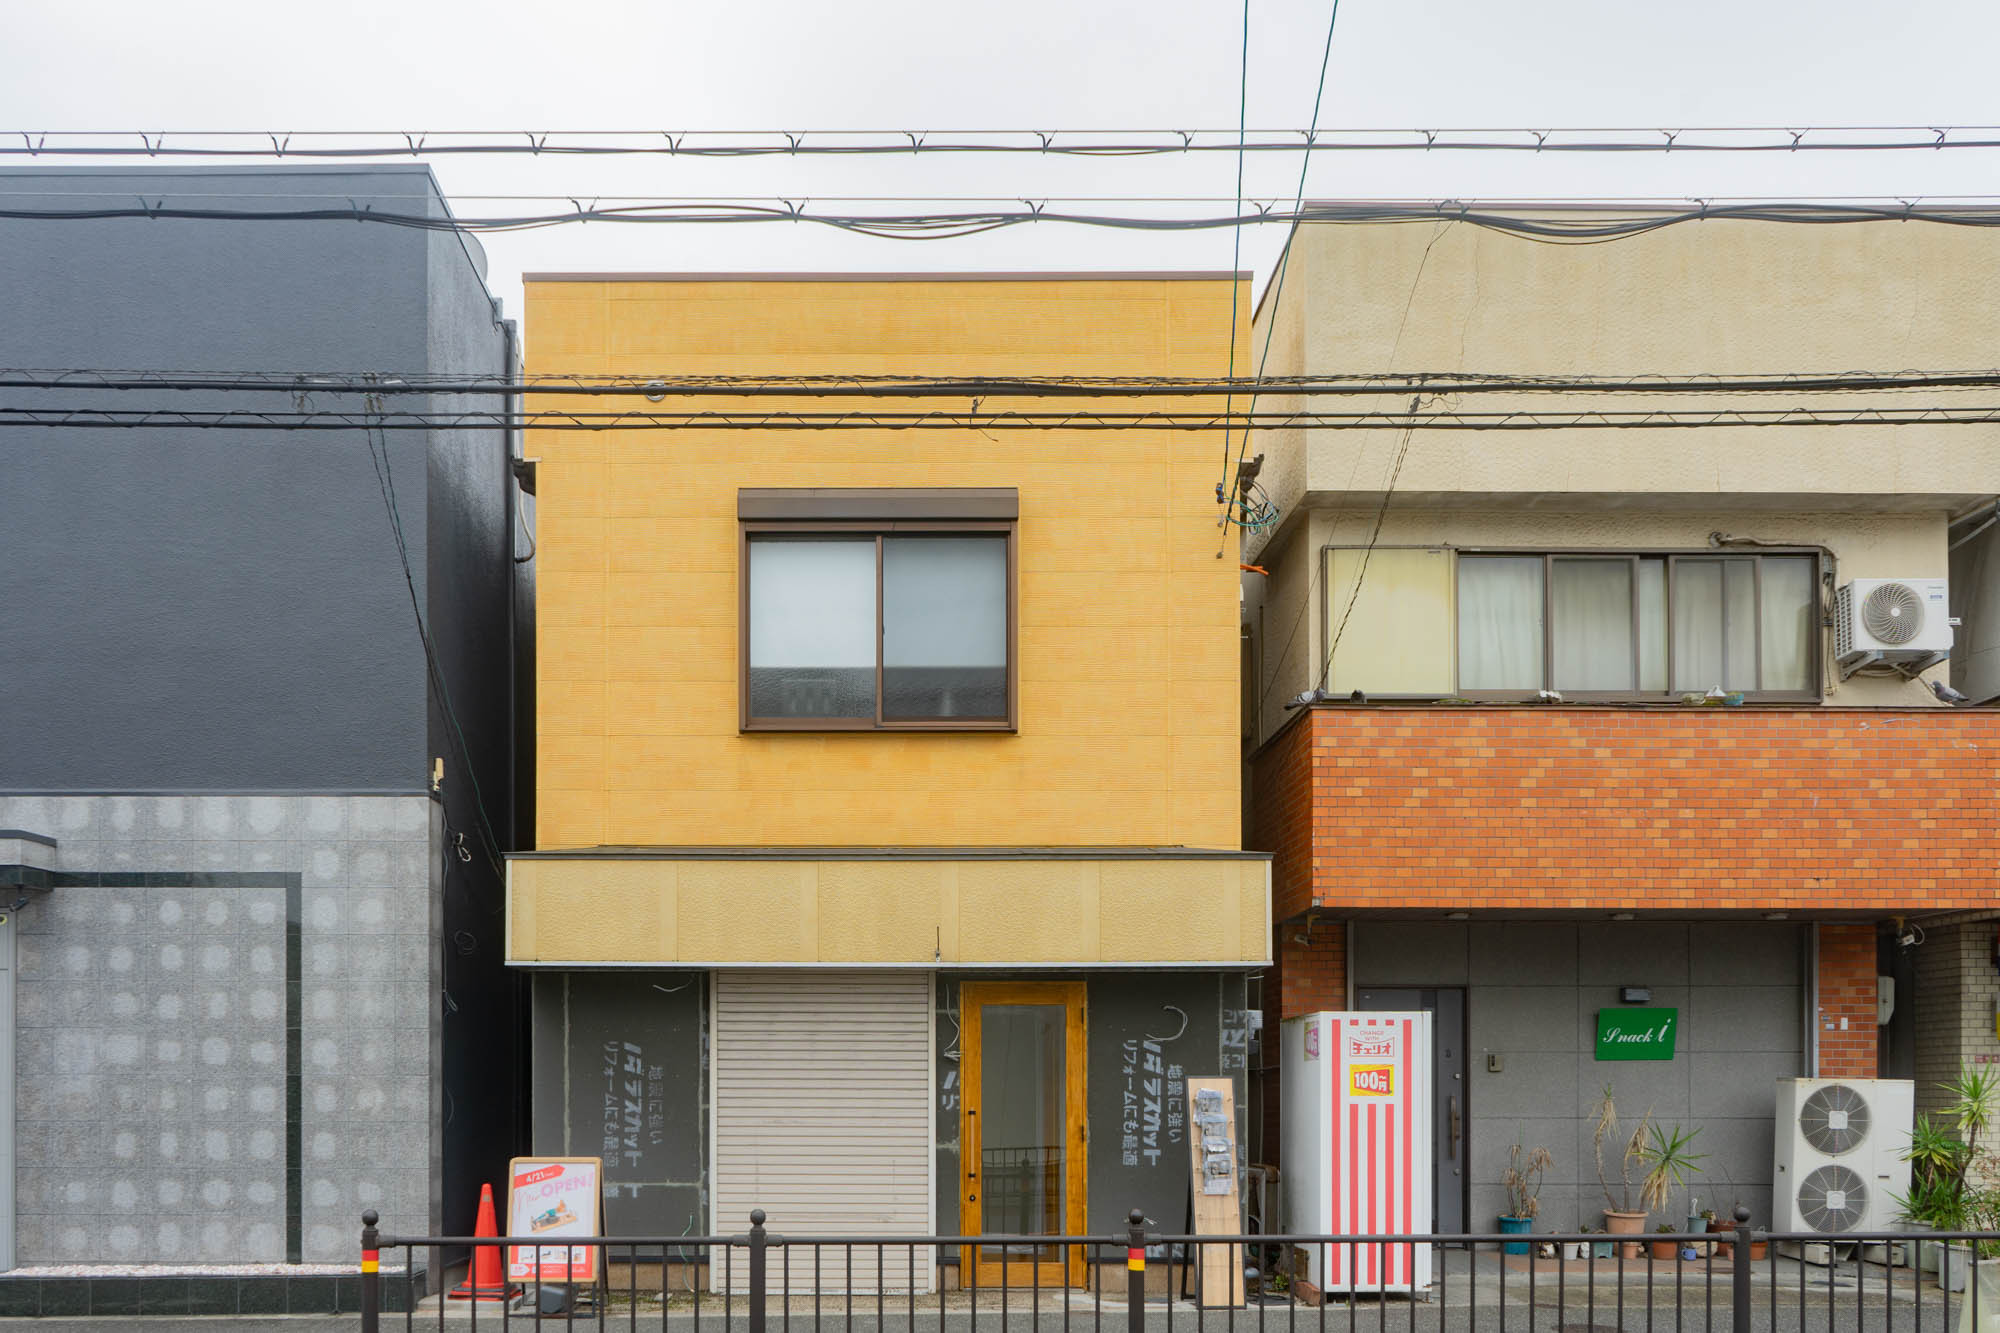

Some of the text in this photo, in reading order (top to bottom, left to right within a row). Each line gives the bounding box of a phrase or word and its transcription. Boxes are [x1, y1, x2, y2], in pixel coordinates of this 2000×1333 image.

[1603, 1027, 1653, 1043] Snack
[1352, 1042, 1391, 1055] チェリオ
[1122, 1039, 1138, 1166] リフォームにも最適
[1168, 1064, 1183, 1143] 地震に強い
[526, 1171, 545, 1184] 4/21
[541, 1172, 595, 1197] OPEN!
